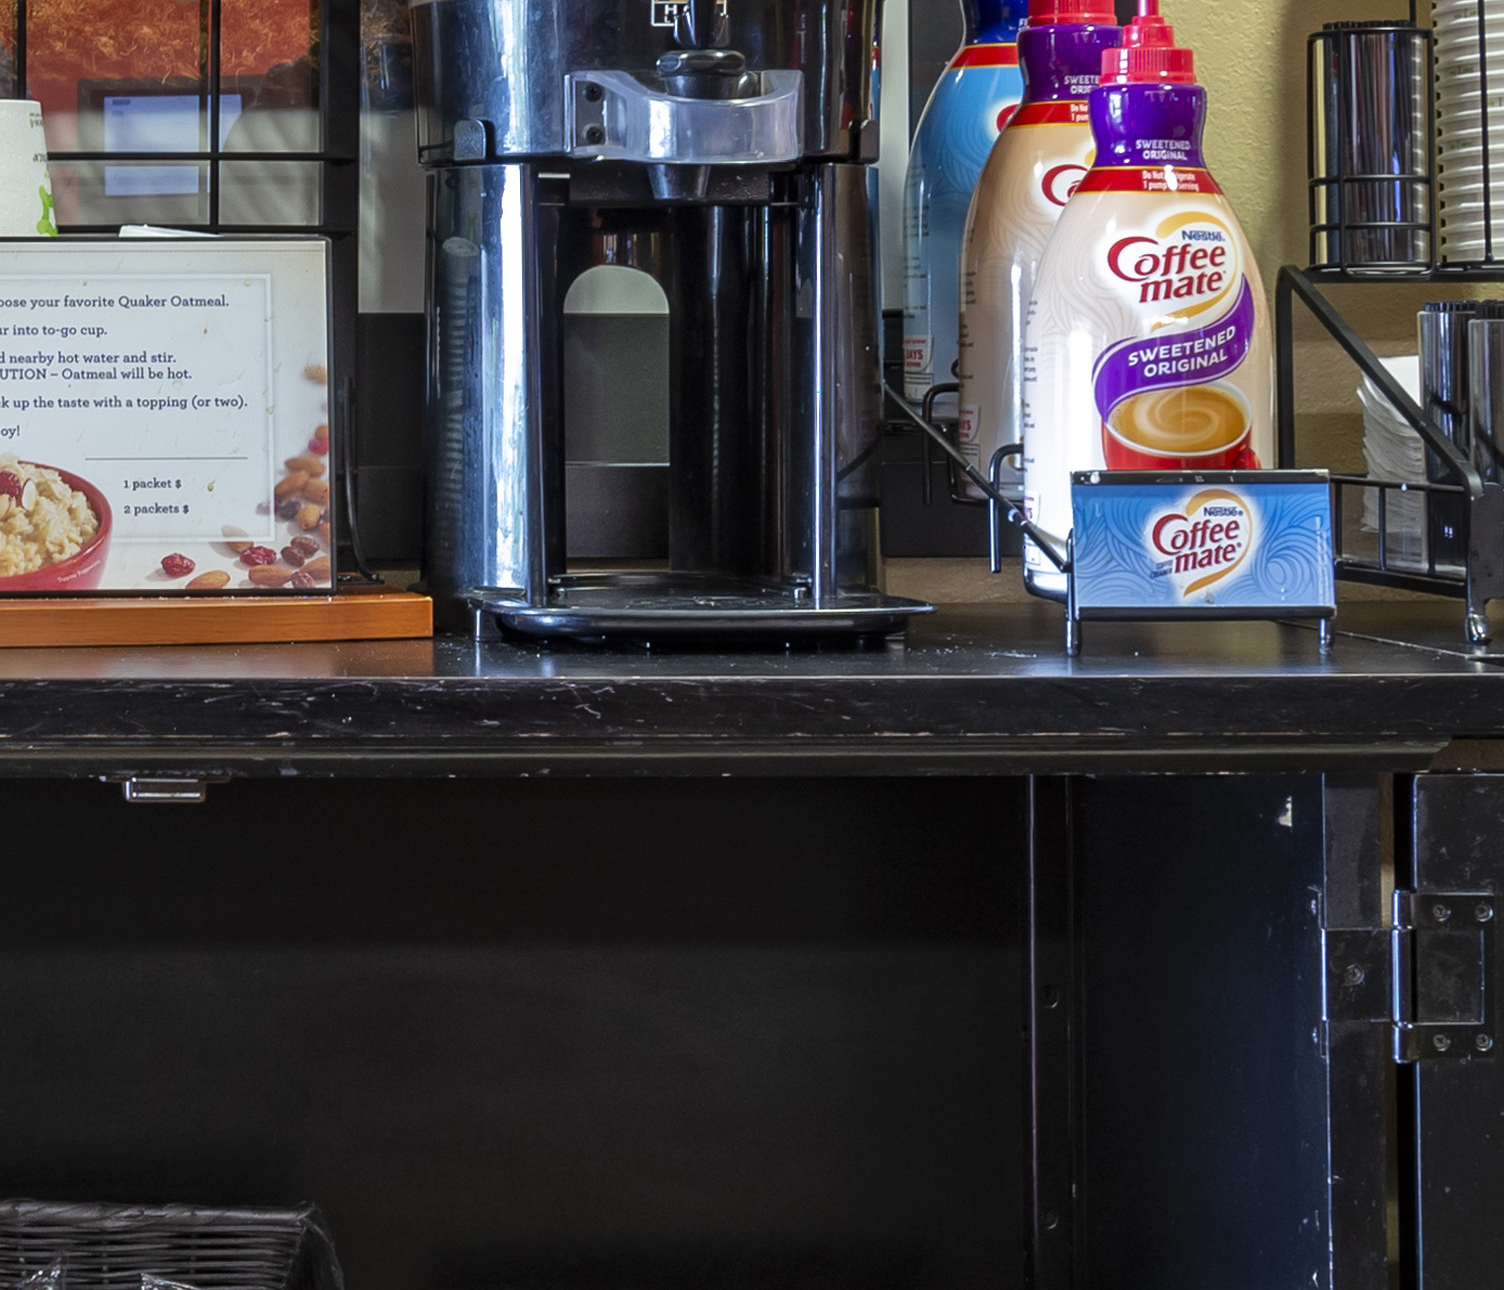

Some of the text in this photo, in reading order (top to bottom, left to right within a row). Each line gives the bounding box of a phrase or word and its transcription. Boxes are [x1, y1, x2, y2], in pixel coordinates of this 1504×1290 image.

[1135, 139, 1191, 151] SWEETENED
[1143, 150, 1188, 161] ORIGINAL
[1107, 236, 1226, 283] Coffee
[1139, 270, 1224, 303] mate
[30, 298, 60, 311] your
[63, 295, 115, 308] favorite
[118, 295, 166, 309] Quaker
[170, 295, 229, 307] Oatmeal.
[12, 325, 39, 336] into
[42, 326, 77, 338] to-go
[80, 326, 107, 338] cup.
[1128, 326, 1236, 366] SWEETENED
[9, 352, 54, 366] nearby
[57, 352, 79, 364] hot
[82, 353, 119, 363] water
[122, 352, 147, 363] and
[151, 352, 176, 363] stir.
[1144, 349, 1228, 377] ORIGINAL
[62, 368, 117, 380] Oatmeal
[120, 367, 144, 379] will
[148, 367, 164, 379] be
[167, 367, 192, 379] hot.
[13, 399, 30, 411] up
[33, 396, 54, 408] the
[57, 397, 90, 408] taste
[93, 395, 122, 408] with
[125, 399, 133, 408] a
[136, 395, 188, 410] topping
[192, 395, 211, 409] (or
[214, 395, 248, 409] two).
[123, 477, 182, 491] 1 packet $
[123, 502, 190, 517] 2 packets $
[1152, 513, 1240, 555] Coffee
[1174, 544, 1235, 573] mate
